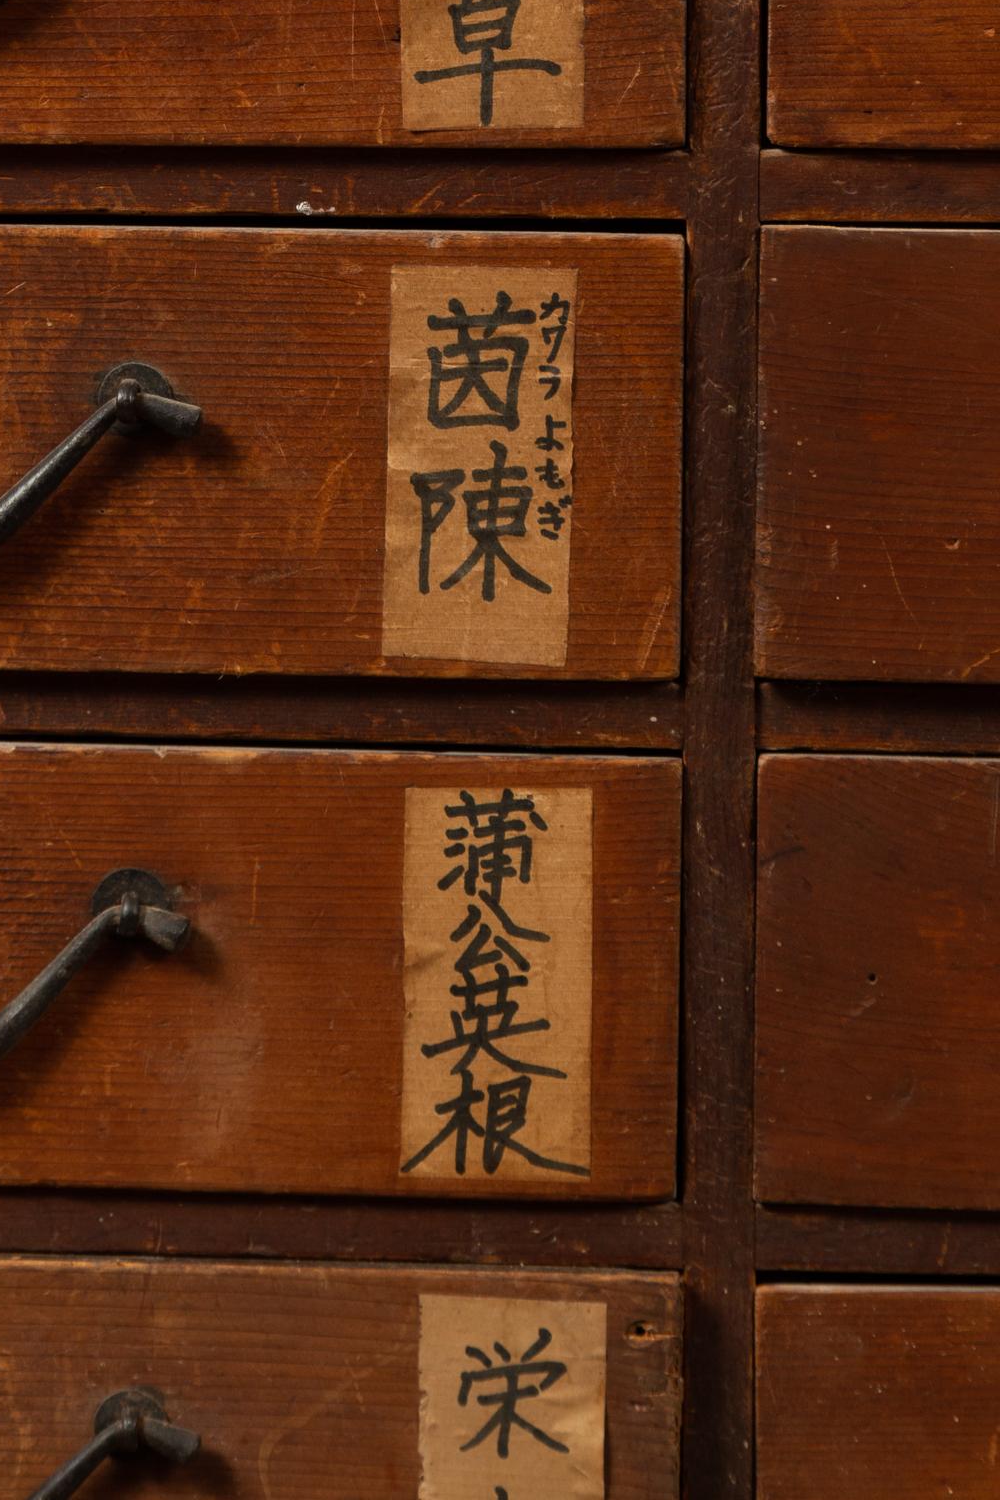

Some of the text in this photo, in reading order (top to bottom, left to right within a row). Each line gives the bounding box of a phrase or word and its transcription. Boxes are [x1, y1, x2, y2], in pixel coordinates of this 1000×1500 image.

[410, 290, 552, 602] 茵陳
[401, 789, 591, 1174] 蒲公英根
[457, 1327, 570, 1500] 栄
